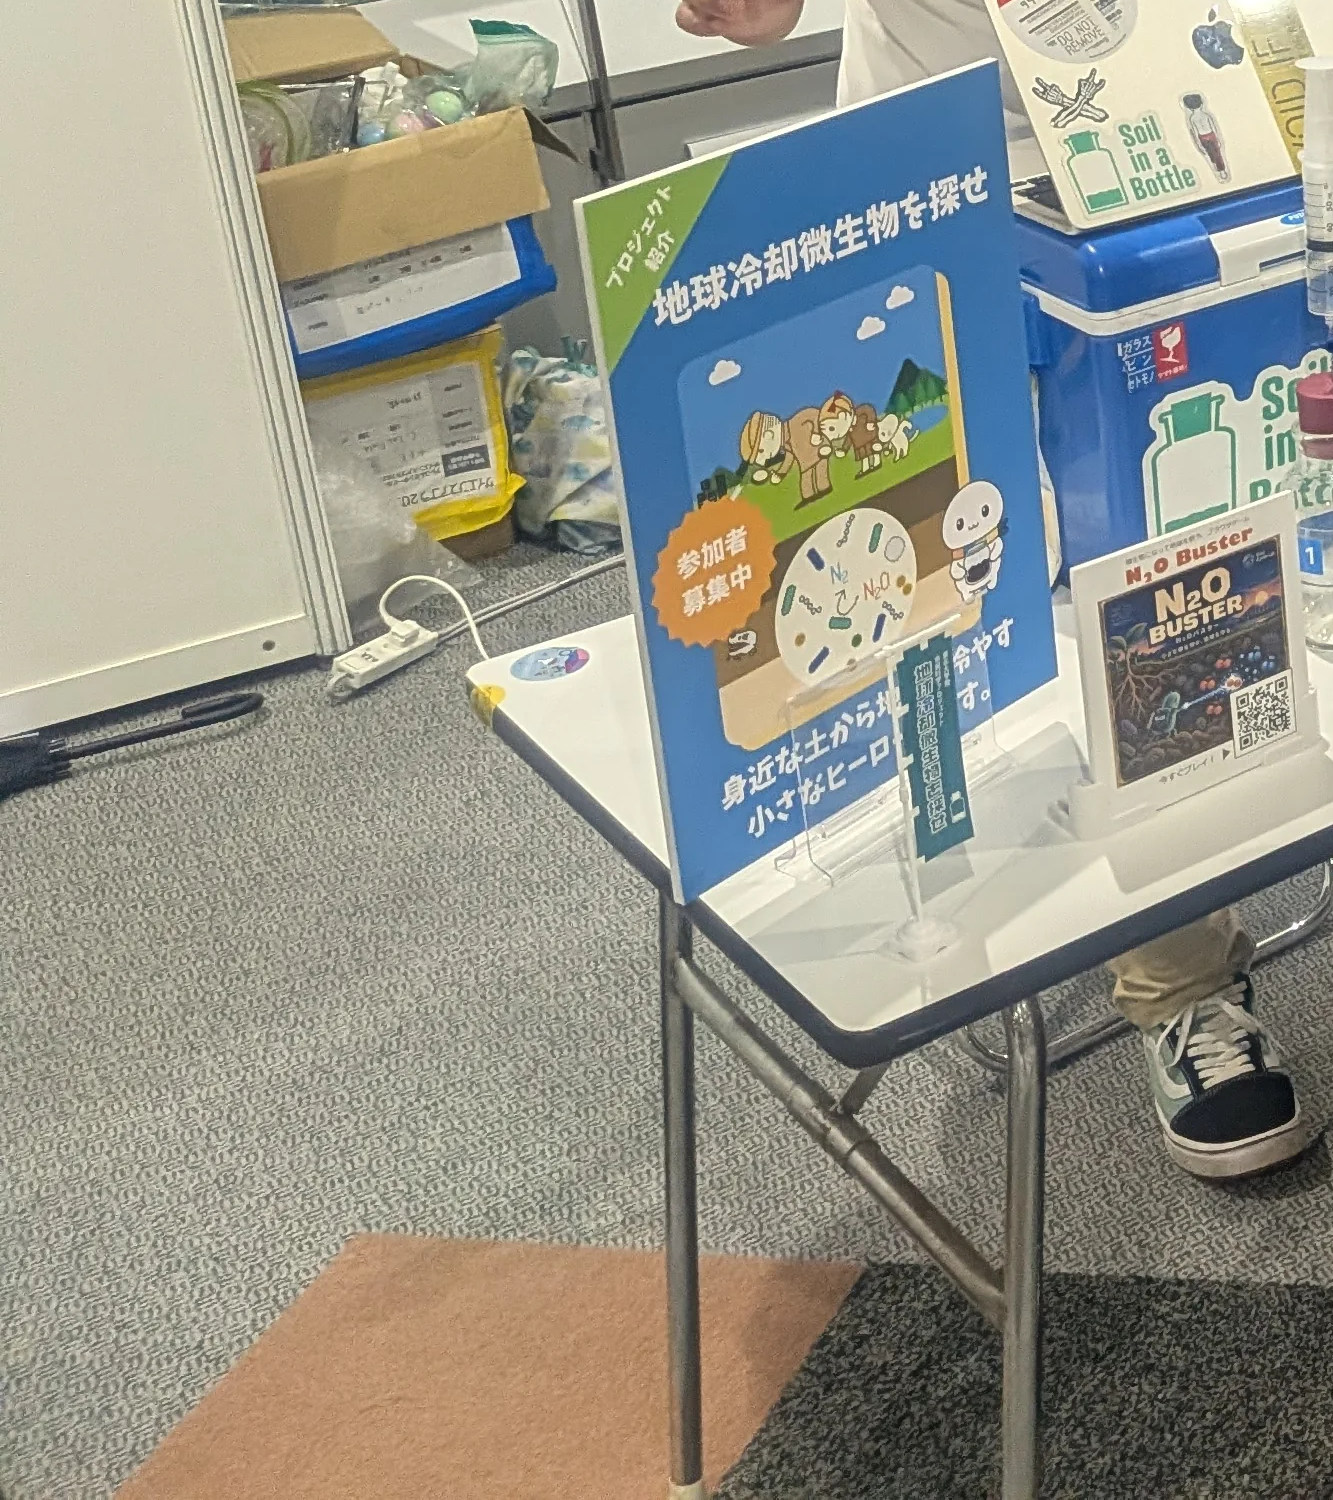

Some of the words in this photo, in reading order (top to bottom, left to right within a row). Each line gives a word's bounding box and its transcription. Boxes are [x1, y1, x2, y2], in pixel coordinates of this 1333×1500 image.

[1056, 31, 1073, 47] DO
[1075, 16, 1098, 35] NOT
[1064, 24, 1106, 56] REMOVE
[1118, 114, 1162, 147] Soil
[1127, 148, 1152, 174] in
[1155, 147, 1171, 167] a
[1129, 164, 1196, 201] Bottle
[606, 183, 673, 290] プロジェクト
[643, 228, 677, 274] 紹介
[652, 164, 989, 328] 地球冷却微生物を探せ
[401, 476, 495, 508] サイエンスアゴラ20
[676, 524, 749, 581] 参加者
[1176, 526, 1254, 568] Buster
[1305, 546, 1314, 566] 1
[681, 562, 753, 619] 募集中
[1149, 594, 1243, 646] BUSTER
